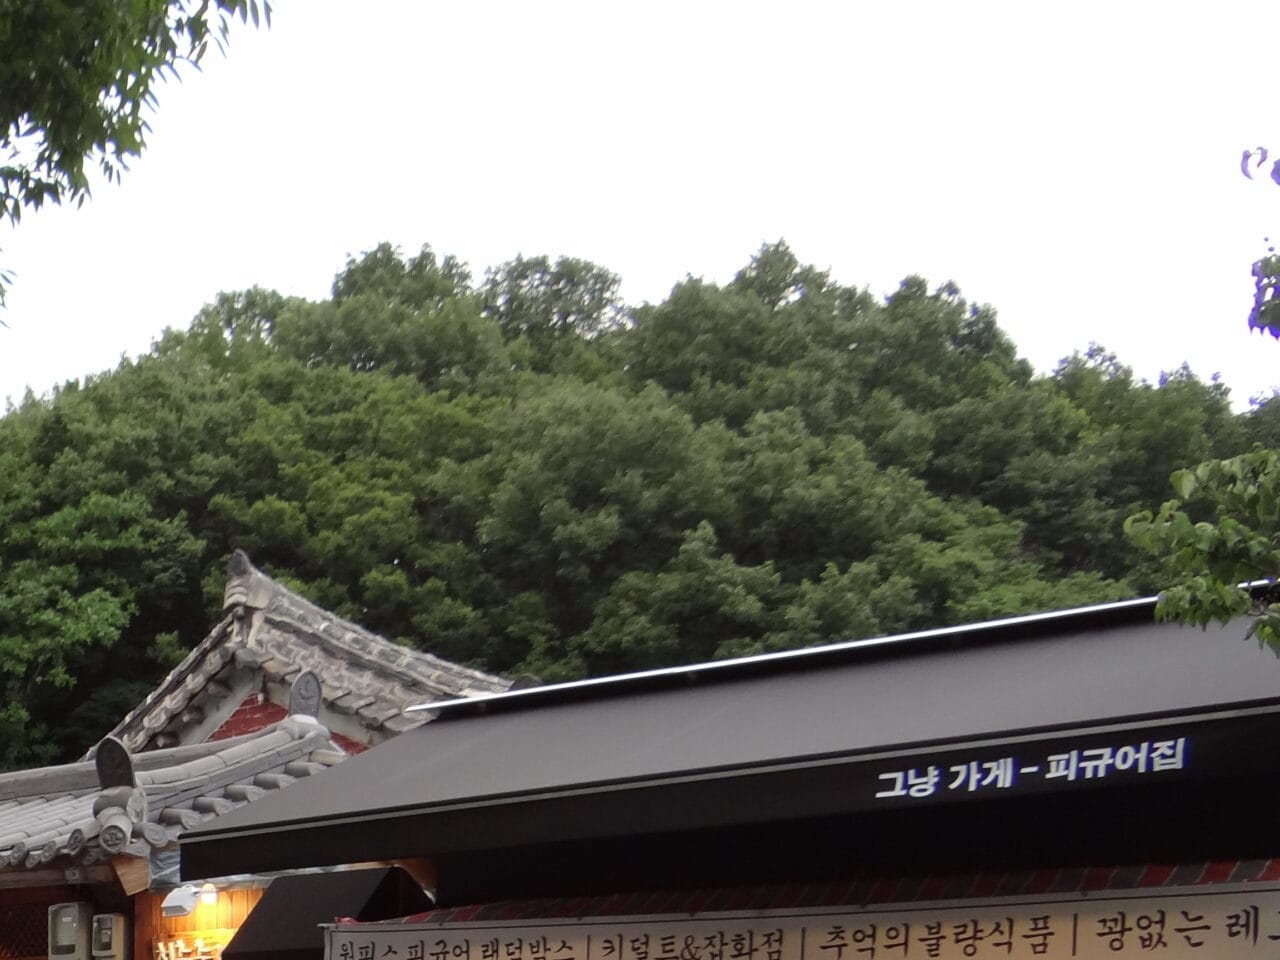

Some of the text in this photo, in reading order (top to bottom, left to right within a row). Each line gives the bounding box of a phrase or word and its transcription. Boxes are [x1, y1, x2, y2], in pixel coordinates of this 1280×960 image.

[875, 766, 938, 798] 그냥
[948, 757, 1014, 792] 가게
[1045, 738, 1186, 781] 피규어집
[1096, 909, 1211, 952] 꽝없는
